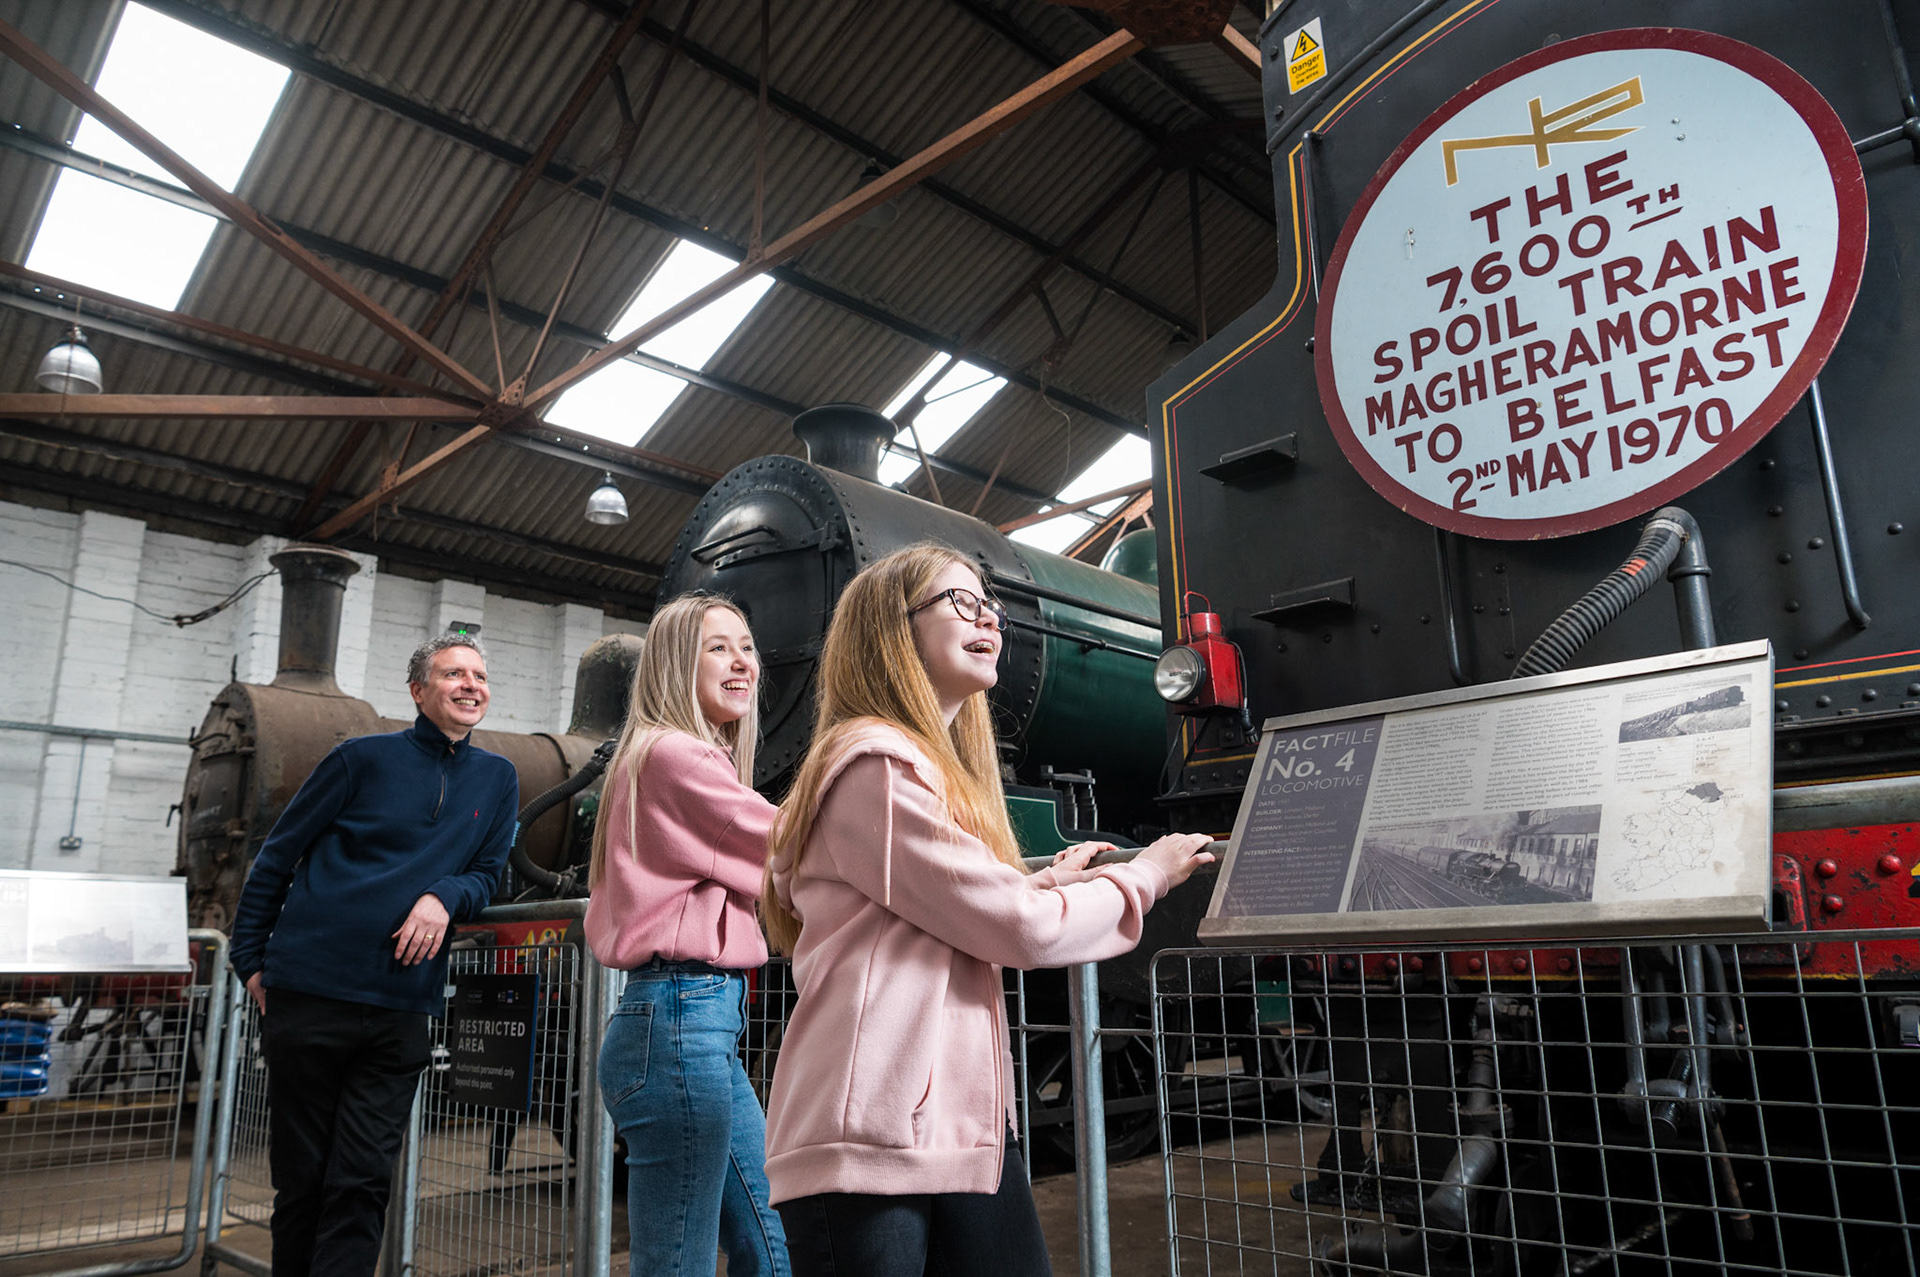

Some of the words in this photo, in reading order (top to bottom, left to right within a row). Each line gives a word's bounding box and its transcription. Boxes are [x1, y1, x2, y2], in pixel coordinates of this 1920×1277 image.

[1292, 54, 1320, 75] Danger
[1470, 150, 1634, 244] THE
[1373, 295, 1537, 383] SPOIL
[1558, 205, 1780, 316] TRAIN
[1365, 256, 1806, 436] MAGHERAMORNE
[1395, 423, 1462, 473] TO
[1507, 318, 1791, 443] BELFAST
[1447, 459, 1501, 512] 2ND
[1506, 430, 1598, 497] MAY
[1607, 398, 1734, 471] 1970
[1274, 728, 1376, 755] FACTFILE
[1265, 756, 1322, 781] No.
[1335, 748, 1356, 772] 4
[1261, 774, 1365, 796] LOCOMOTIVE
[458, 1019, 526, 1037] RESTRICTED
[458, 1036, 485, 1053] AREA
[480, 1065, 504, 1077] personnel
[504, 1066, 516, 1080] only
